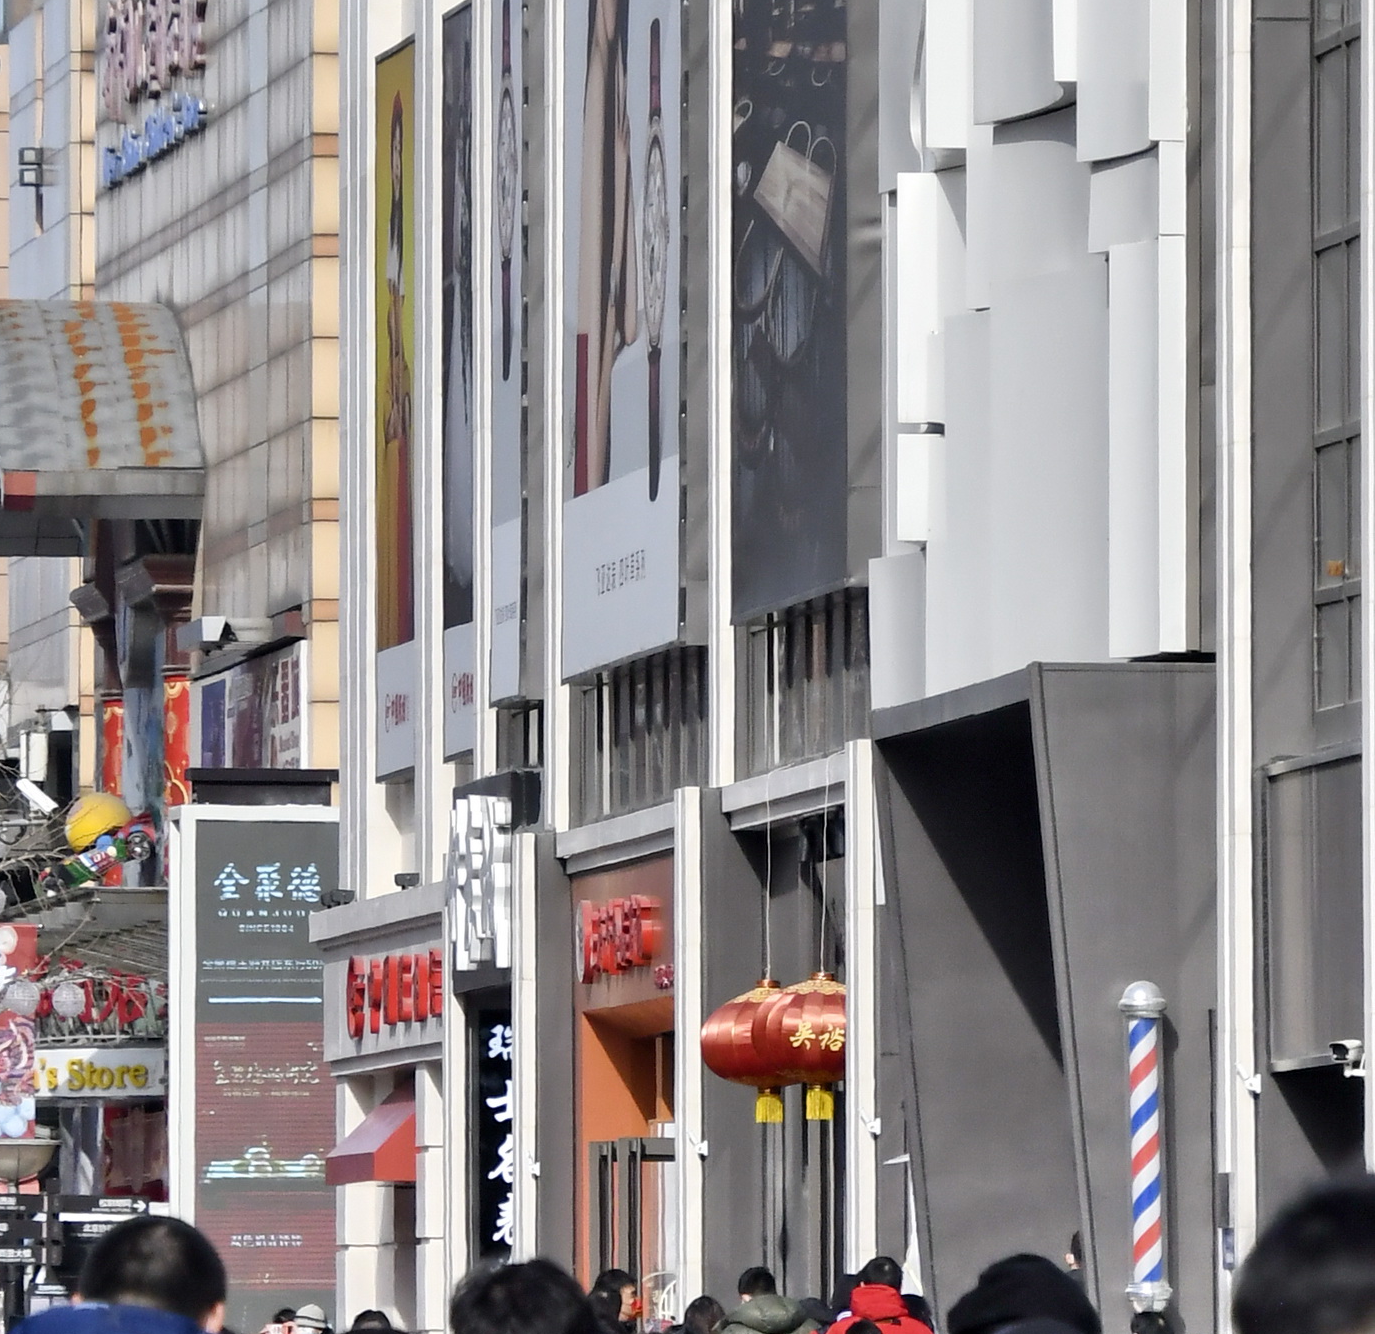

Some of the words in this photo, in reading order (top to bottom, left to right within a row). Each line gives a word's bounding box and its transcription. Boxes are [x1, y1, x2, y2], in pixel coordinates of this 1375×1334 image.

[213, 861, 322, 903] 全聚德
[789, 1021, 846, 1052] 吴裕
[66, 1059, 149, 1091] Store
